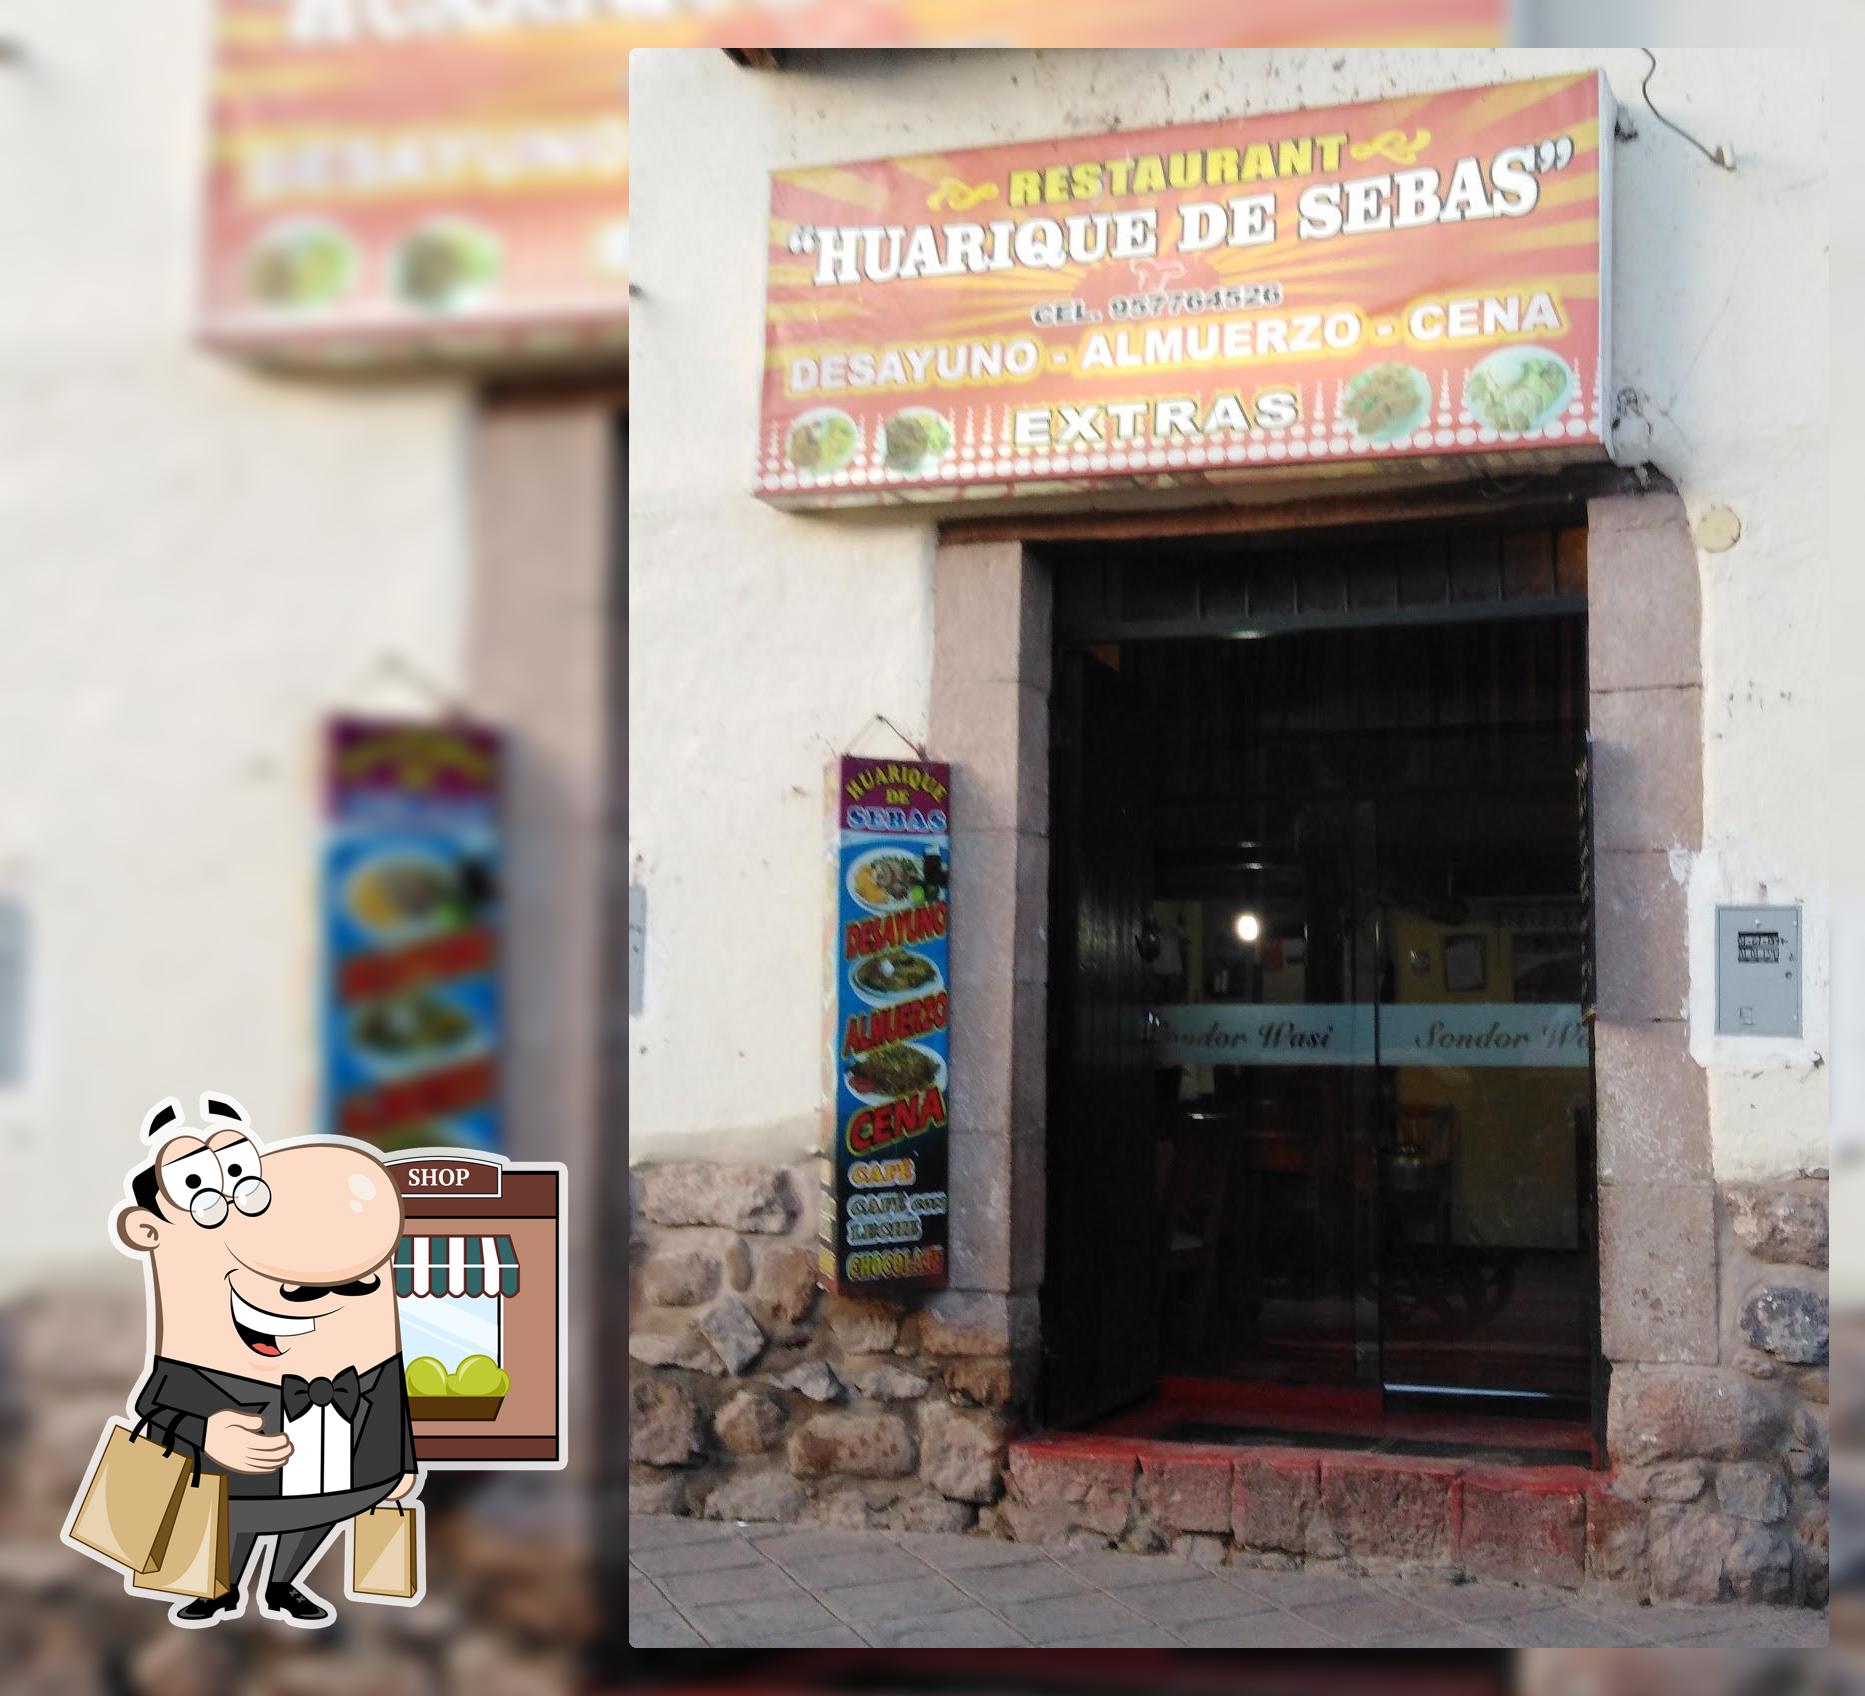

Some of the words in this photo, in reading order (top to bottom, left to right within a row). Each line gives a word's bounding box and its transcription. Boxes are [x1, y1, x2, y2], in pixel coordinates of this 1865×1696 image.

[1009, 133, 1348, 207] RESTAURANT
[1177, 193, 1276, 253] DE
[1032, 298, 1103, 327] CEL.
[789, 338, 1038, 392] DESAYUNO
[1082, 312, 1361, 370] ALMUERZO
[1409, 292, 1562, 341] CENA
[1014, 391, 1299, 447] EXTRAS
[846, 763, 948, 801] HUARIQUE
[885, 788, 910, 804] DE
[847, 806, 947, 832] SEBAS
[847, 902, 948, 957] DESAYUNO
[1257, 1020, 1334, 1050] Wasi
[1415, 1021, 1530, 1050] Sondor
[847, 1084, 946, 1155] CENA
